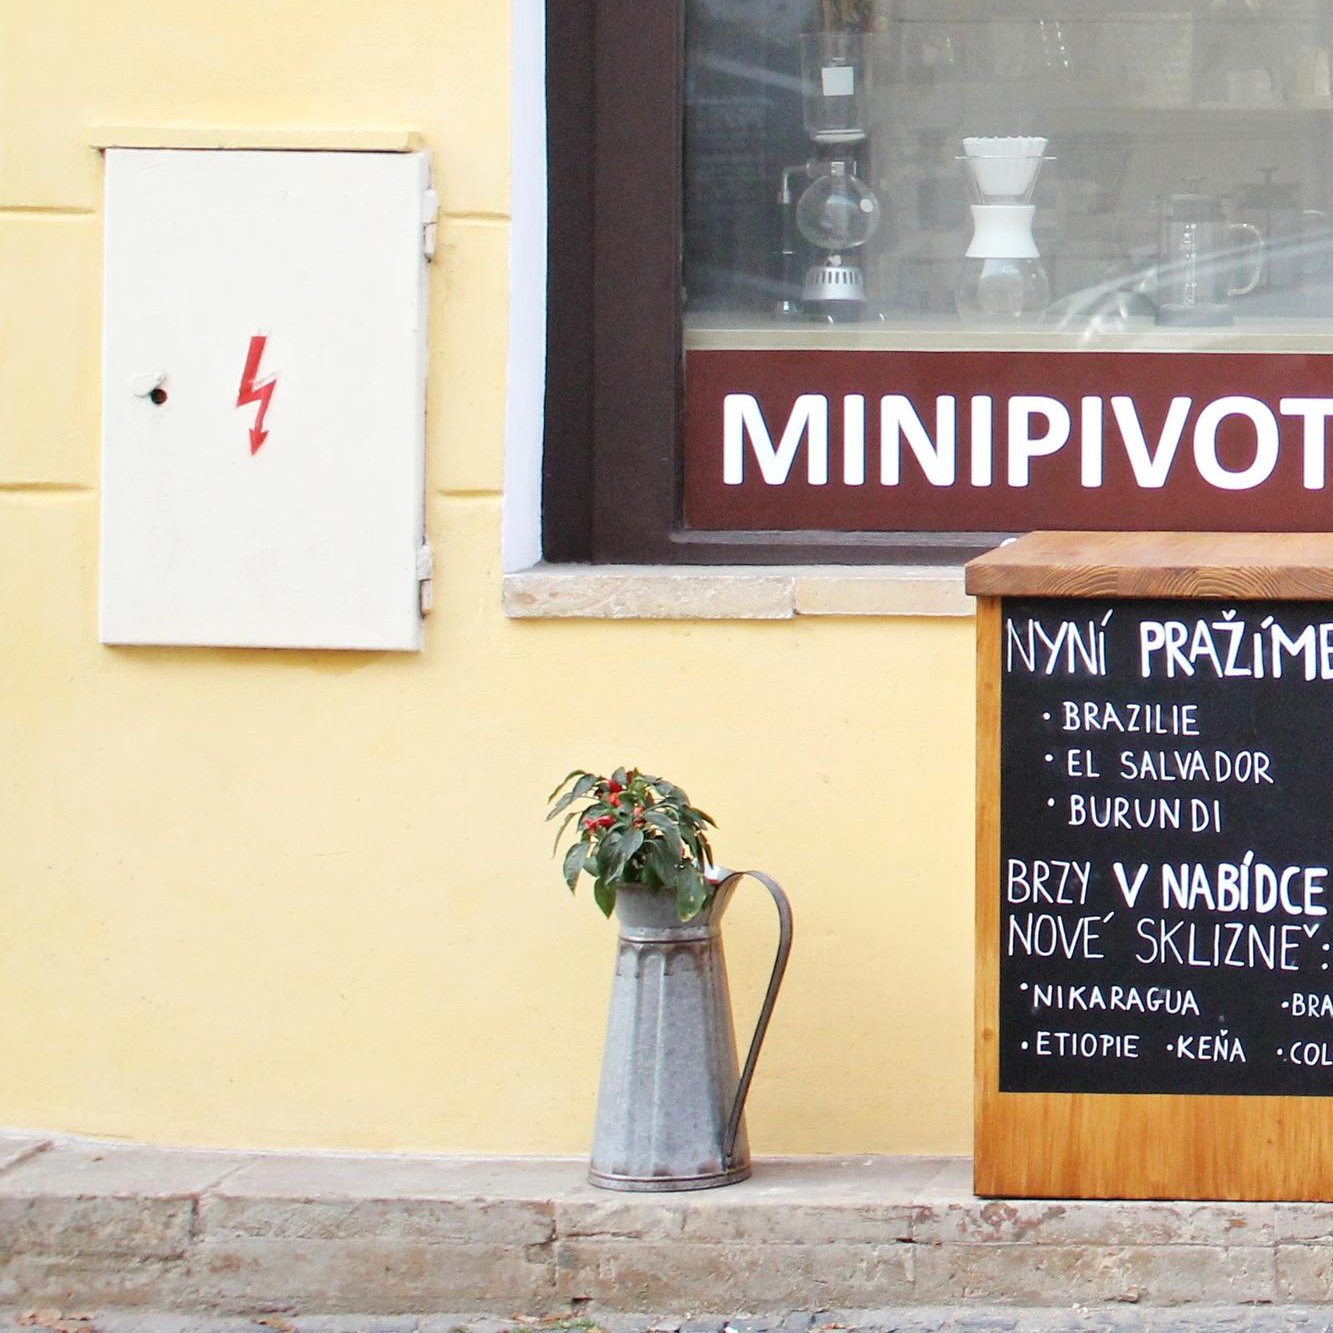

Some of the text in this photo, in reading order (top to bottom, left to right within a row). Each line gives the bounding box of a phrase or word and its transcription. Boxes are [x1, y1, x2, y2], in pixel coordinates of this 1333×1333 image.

[1006, 608, 1114, 676] NYNÍ
[1062, 701, 1200, 736] BRAZILIE
[1067, 748, 1274, 784] EL SALVADOR
[1068, 797, 1221, 833] BURUNDI
[1007, 849, 1329, 916] BRZY V NABÍDCE
[1008, 911, 1115, 959] NOVÉ
[1033, 984, 1200, 1016] NIKARAGUA
[1036, 1030, 1140, 1058] ETIOPIE
[1177, 1028, 1247, 1063] KEŇA
